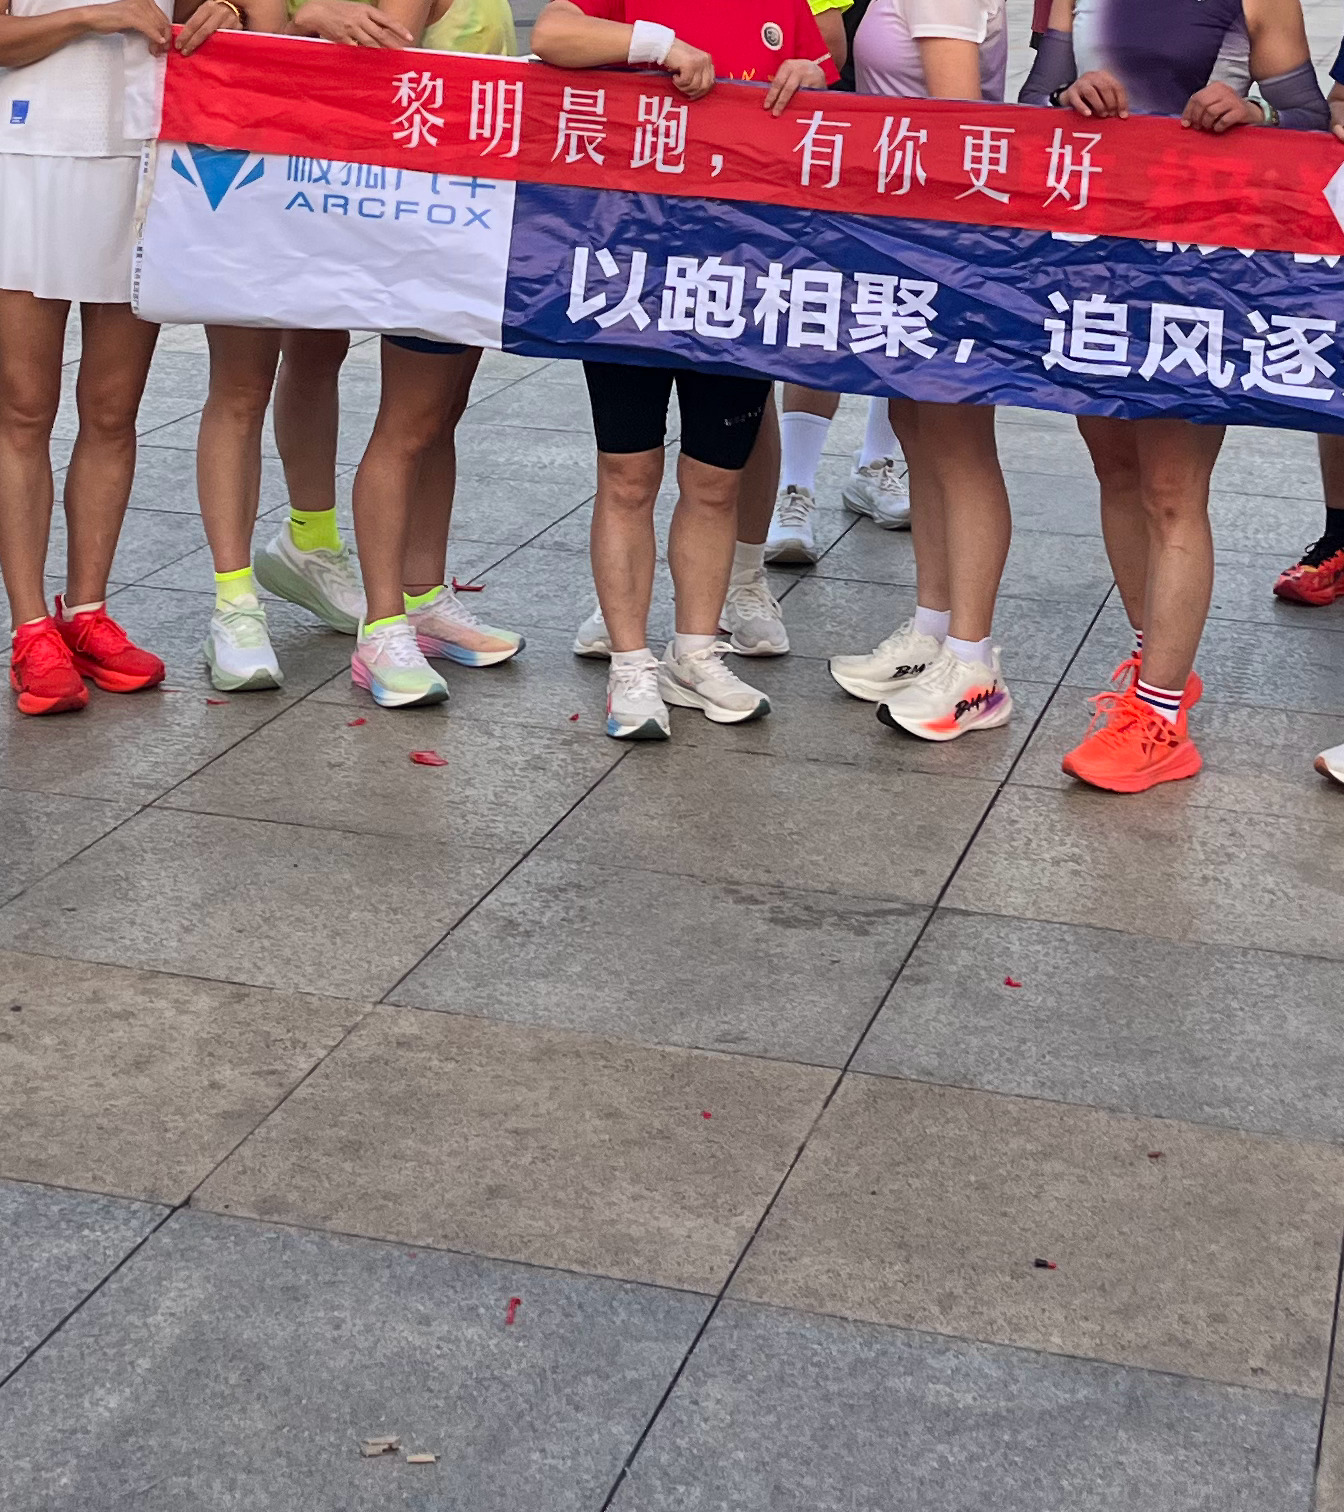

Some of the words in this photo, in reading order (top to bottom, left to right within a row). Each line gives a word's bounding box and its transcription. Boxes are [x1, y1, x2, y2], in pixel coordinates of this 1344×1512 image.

[391, 70, 1103, 211] 黎明晨跑，有你更好
[284, 191, 492, 230] ARCFOX
